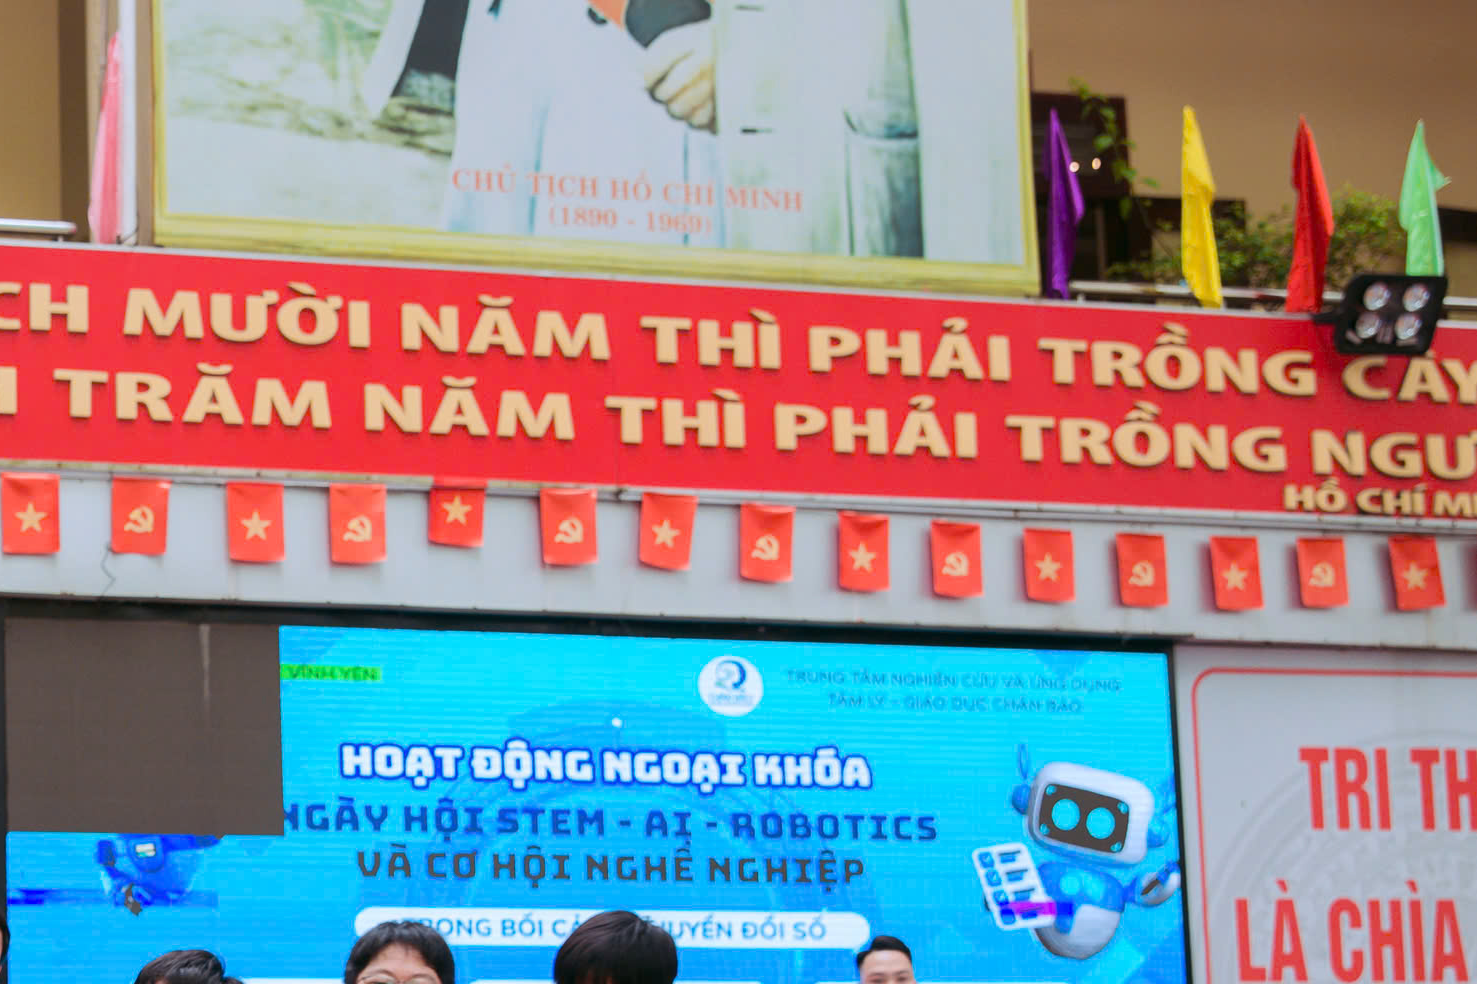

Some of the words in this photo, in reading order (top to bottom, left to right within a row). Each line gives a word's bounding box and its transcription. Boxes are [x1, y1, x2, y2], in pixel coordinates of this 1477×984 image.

[452, 162, 517, 193] CHỦ
[611, 168, 653, 202] HỒ
[662, 176, 716, 207] CHÍ
[725, 186, 804, 213] MINH
[549, 205, 618, 228] (1890
[646, 210, 713, 239] 1969)
[124, 282, 370, 347] MƯỜI
[402, 295, 610, 359] NĂM
[641, 310, 780, 368] THÌ
[809, 318, 1010, 380] PHẢI
[1037, 322, 1317, 396] TRỒNG
[54, 363, 331, 427] TRĂM
[364, 376, 574, 439] NĂM
[605, 389, 745, 447] THÌ
[775, 395, 977, 457] PHẢI
[1006, 402, 1286, 471] TRỒNG
[1283, 477, 1348, 513] HỒ
[1356, 483, 1427, 515] CHÍ
[340, 743, 463, 790] HOẠT
[470, 738, 594, 791] ĐỘNG
[602, 749, 746, 794] NGOẠI
[753, 745, 873, 789] KHÓA
[1299, 747, 1391, 831] TRI
[404, 797, 483, 841] HỘI
[496, 808, 605, 837] STEM
[645, 810, 692, 837] AI
[732, 813, 938, 841] ROBOTICS
[357, 843, 411, 878] VÀ
[428, 850, 477, 878] CƠ
[493, 845, 570, 888] HỘI
[587, 840, 693, 881] NGHỀ
[709, 850, 864, 892] NGHIỆP
[1235, 880, 1308, 982] LÀ
[1328, 880, 1468, 983] CHÌA
